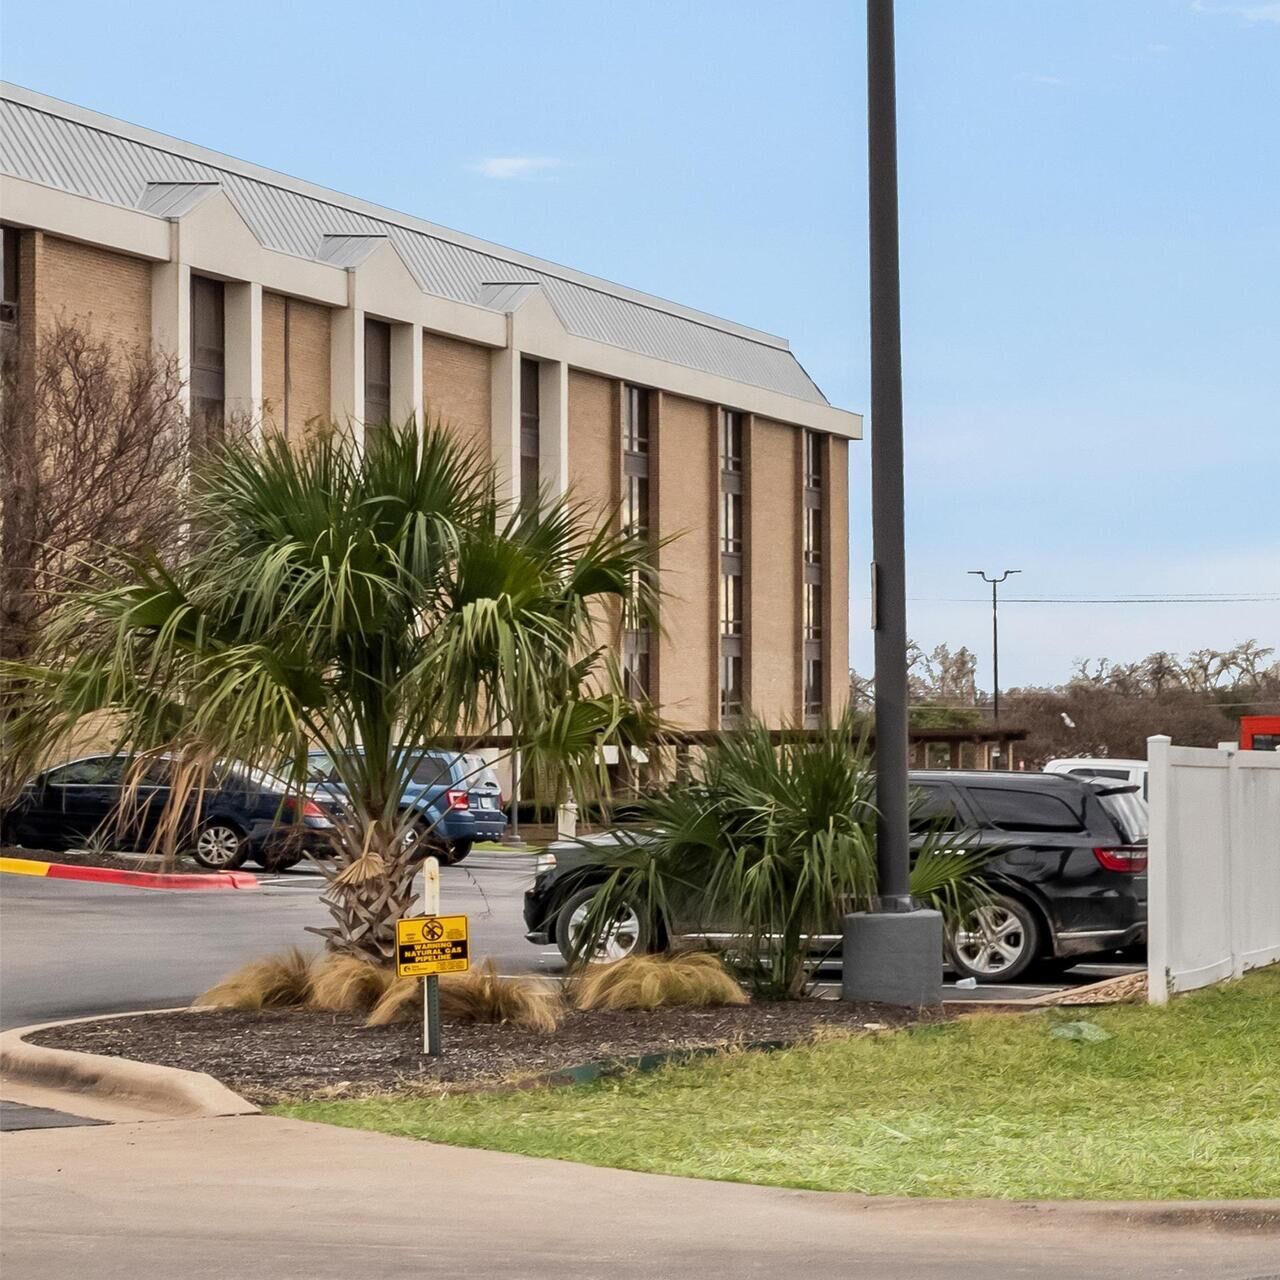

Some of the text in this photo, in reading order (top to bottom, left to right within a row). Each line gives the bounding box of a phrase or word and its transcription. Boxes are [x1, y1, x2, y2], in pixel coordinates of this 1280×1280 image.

[414, 942, 452, 951] WARNING
[404, 946, 462, 958] NATURAL GAS
[415, 954, 452, 963] PIPELINE
